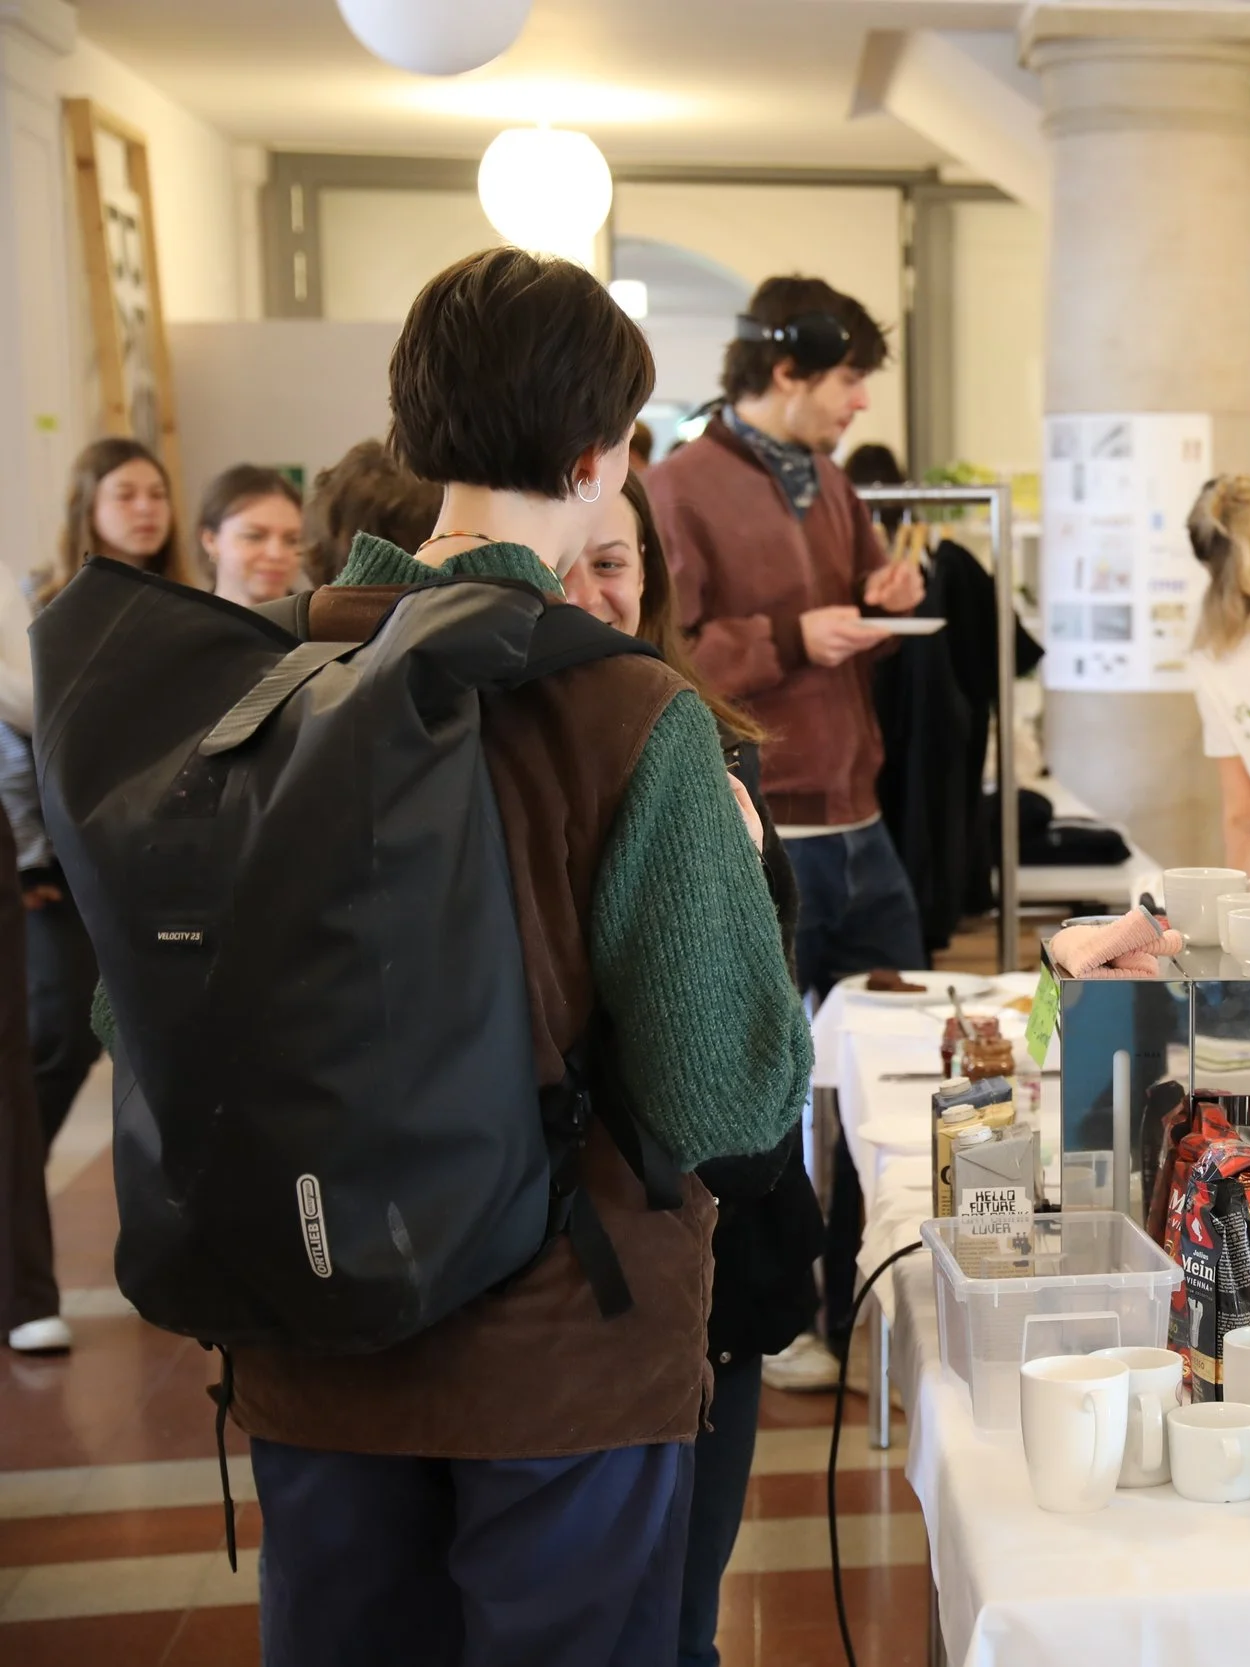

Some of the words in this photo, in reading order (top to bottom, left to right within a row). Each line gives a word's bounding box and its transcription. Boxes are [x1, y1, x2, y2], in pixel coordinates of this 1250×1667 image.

[157, 931, 190, 940] VELOCITY
[190, 932, 201, 940] 23
[975, 1189, 1015, 1202] HELLO
[970, 1201, 1016, 1213] FUTURE
[307, 1223, 327, 1273] ORTLIEB
[1186, 1275, 1209, 1292] VIENNA
